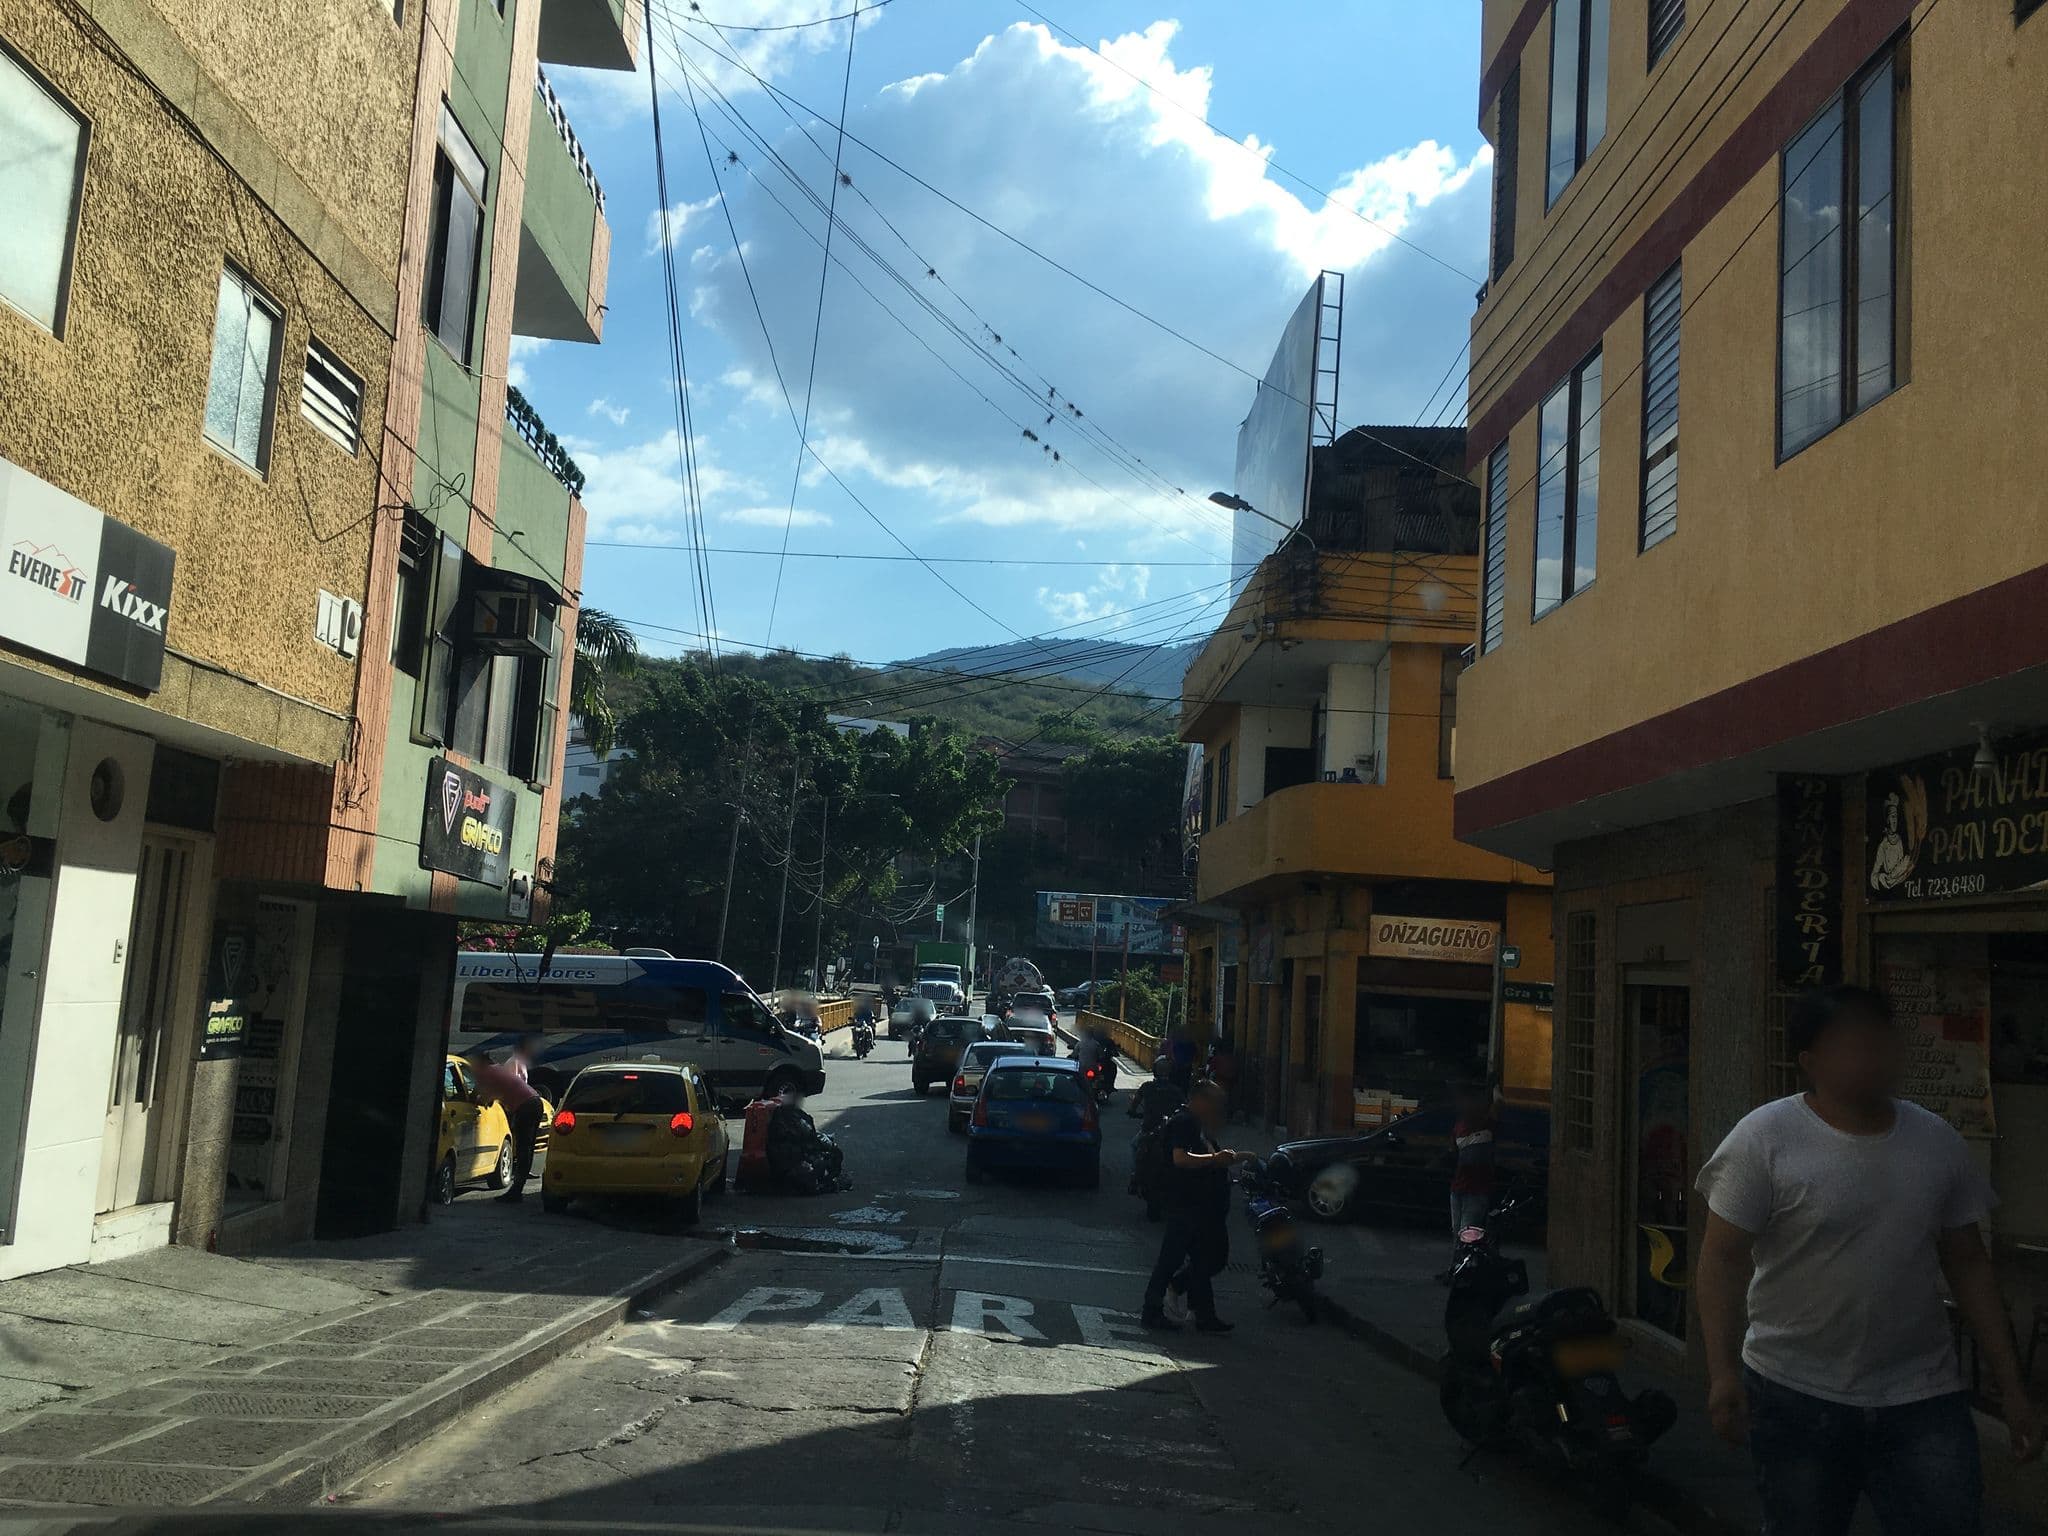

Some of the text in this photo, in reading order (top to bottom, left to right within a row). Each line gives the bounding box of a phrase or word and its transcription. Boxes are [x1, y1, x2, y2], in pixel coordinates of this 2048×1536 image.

[101, 574, 167, 632] Kixx
[1929, 820, 1987, 865] PAN
[701, 1286, 1158, 1348] PARE
